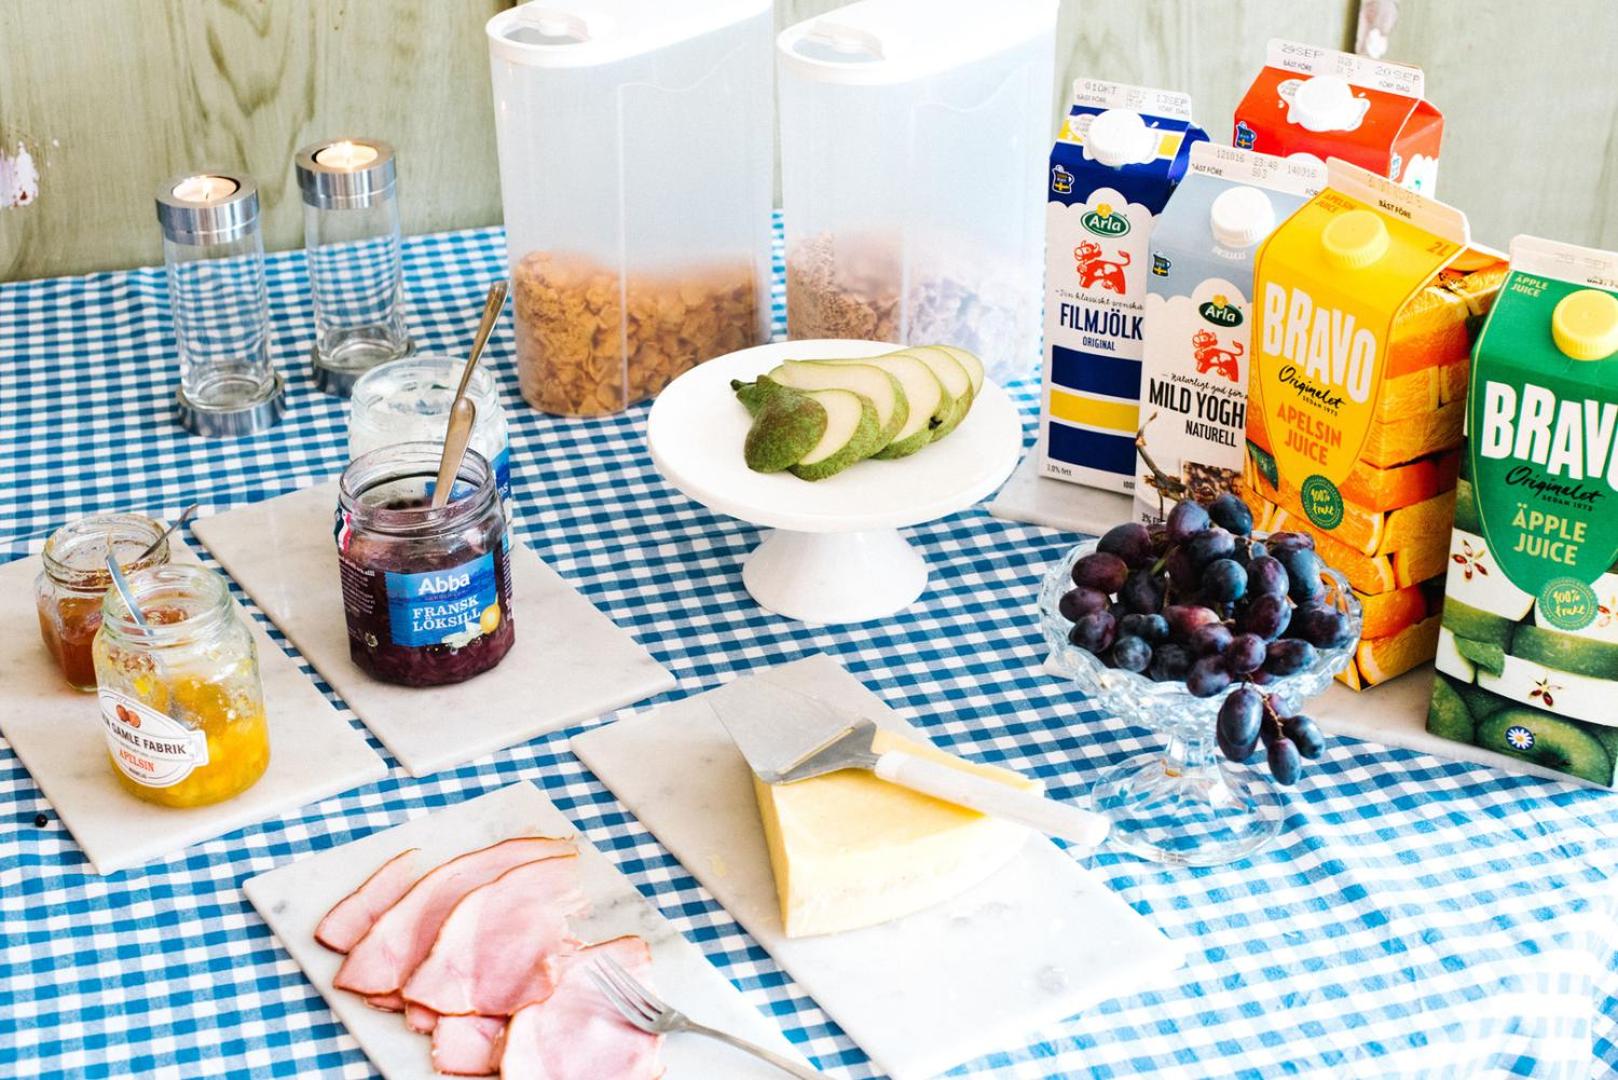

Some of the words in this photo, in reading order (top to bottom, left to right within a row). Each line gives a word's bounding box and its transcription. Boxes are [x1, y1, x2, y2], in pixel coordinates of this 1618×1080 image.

[1089, 215, 1122, 233] Arla
[1510, 283, 1542, 298] JUICE
[1060, 303, 1144, 341] FILMJÖLK
[1204, 304, 1237, 323] Arla
[1082, 335, 1117, 351] ORIGINAL
[1262, 281, 1377, 405] BRAVO
[1149, 378, 1191, 415] MILD
[1195, 391, 1247, 430] YOGH
[1278, 365, 1346, 409] Originalet
[1185, 419, 1237, 448] NATURELL
[1277, 402, 1342, 449] APELSIN
[1284, 429, 1329, 467] JUICE
[1505, 465, 1605, 503] Originalet
[1511, 502, 1588, 543] ÄPPLE
[1513, 532, 1578, 566] JUICE
[418, 572, 471, 596] Abba
[412, 593, 480, 620] FRANSK
[412, 606, 481, 633] LÖKSILL
[111, 721, 141, 746] GAMLE
[143, 738, 187, 755] FABRIK
[119, 749, 155, 773] APELSIN
